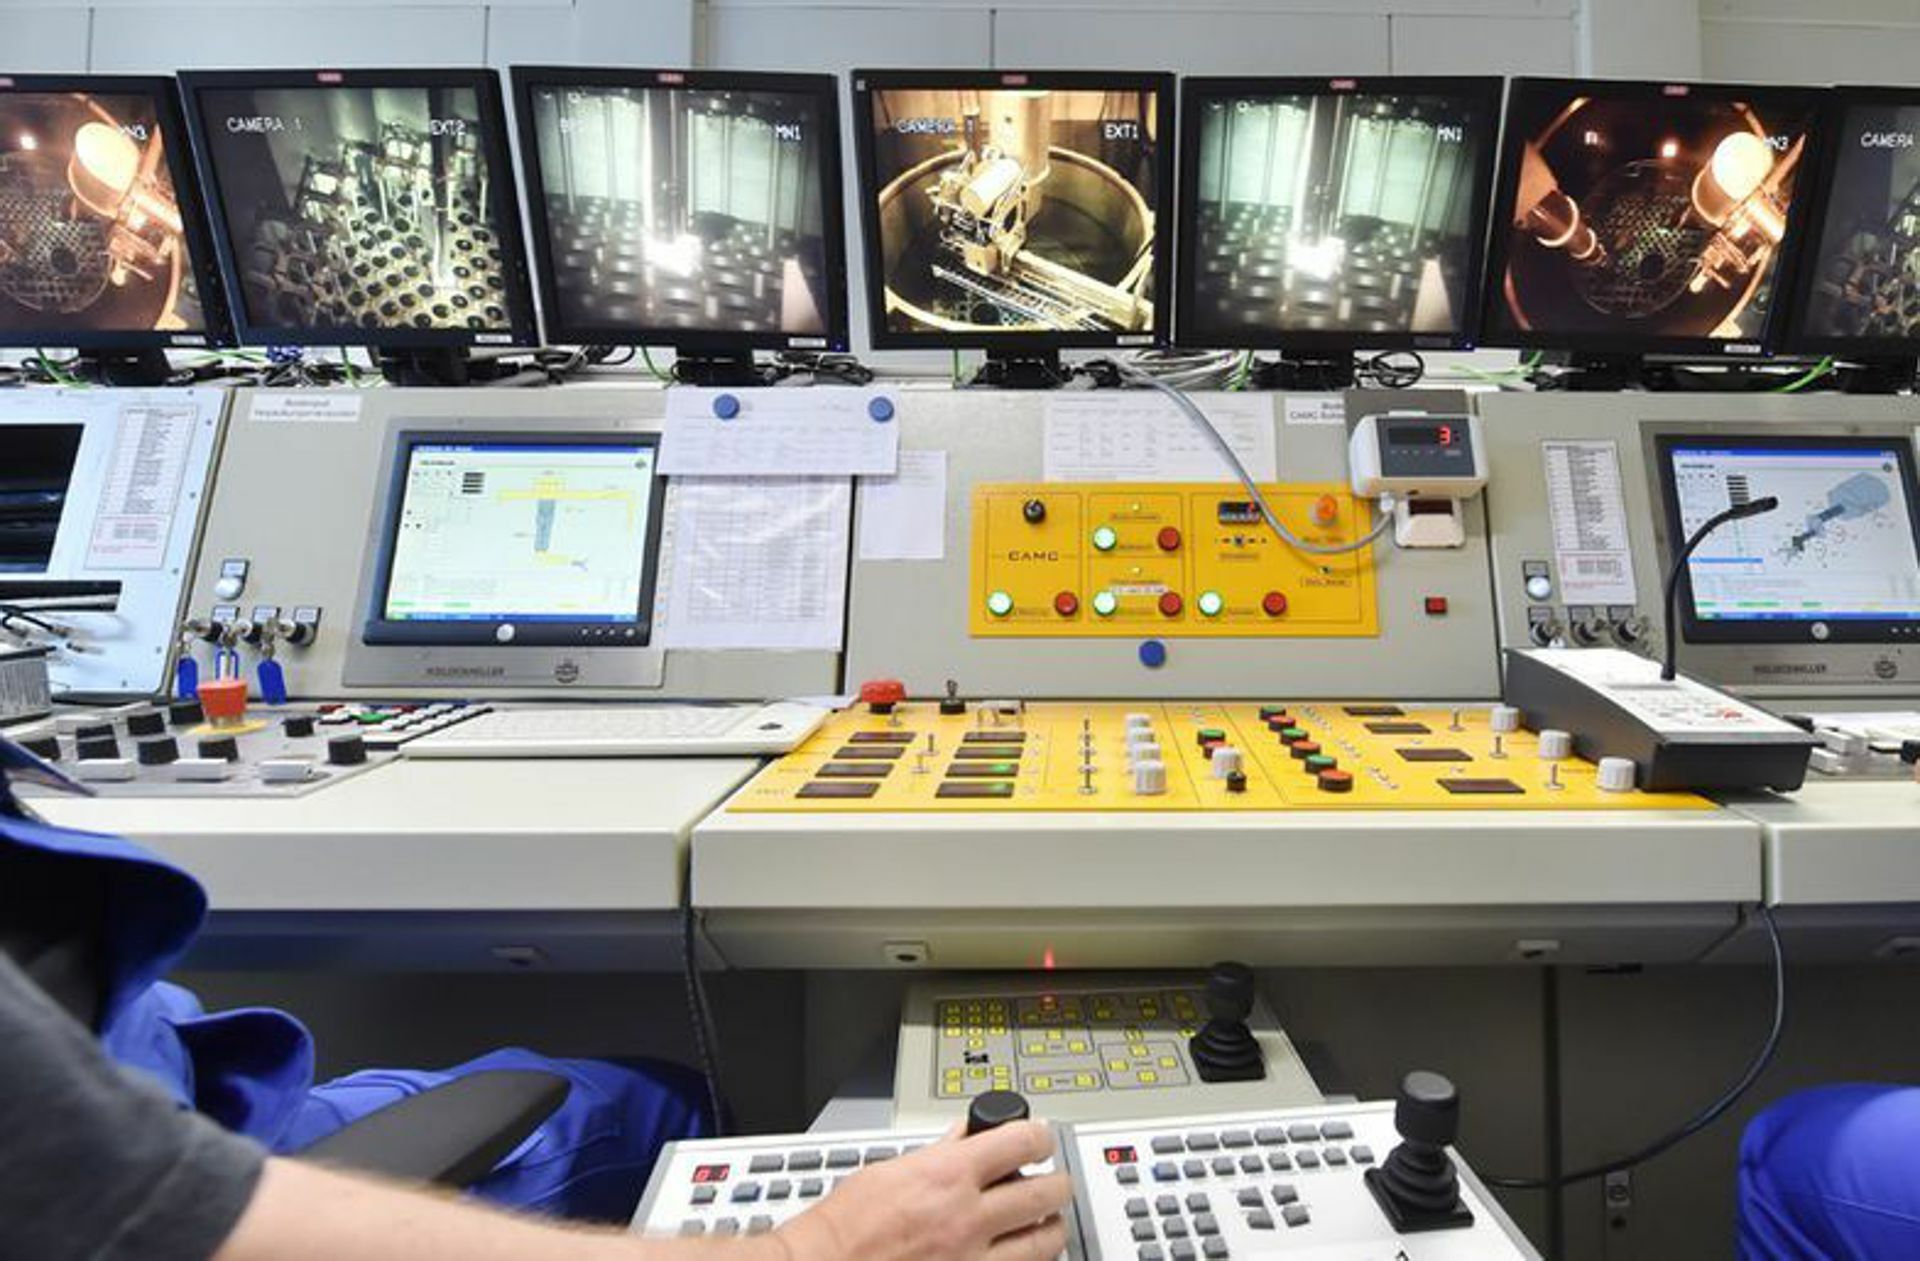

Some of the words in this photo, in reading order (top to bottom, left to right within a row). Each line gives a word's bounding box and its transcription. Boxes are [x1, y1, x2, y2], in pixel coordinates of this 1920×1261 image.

[227, 117, 285, 132] CAMERA
[431, 119, 466, 136] EXT2
[775, 123, 801, 140] MN1
[1104, 123, 1139, 140] EXT1
[1860, 132, 1914, 148] CAMERA
[1438, 424, 1451, 448] 3
[1008, 550, 1059, 562] CAMC
